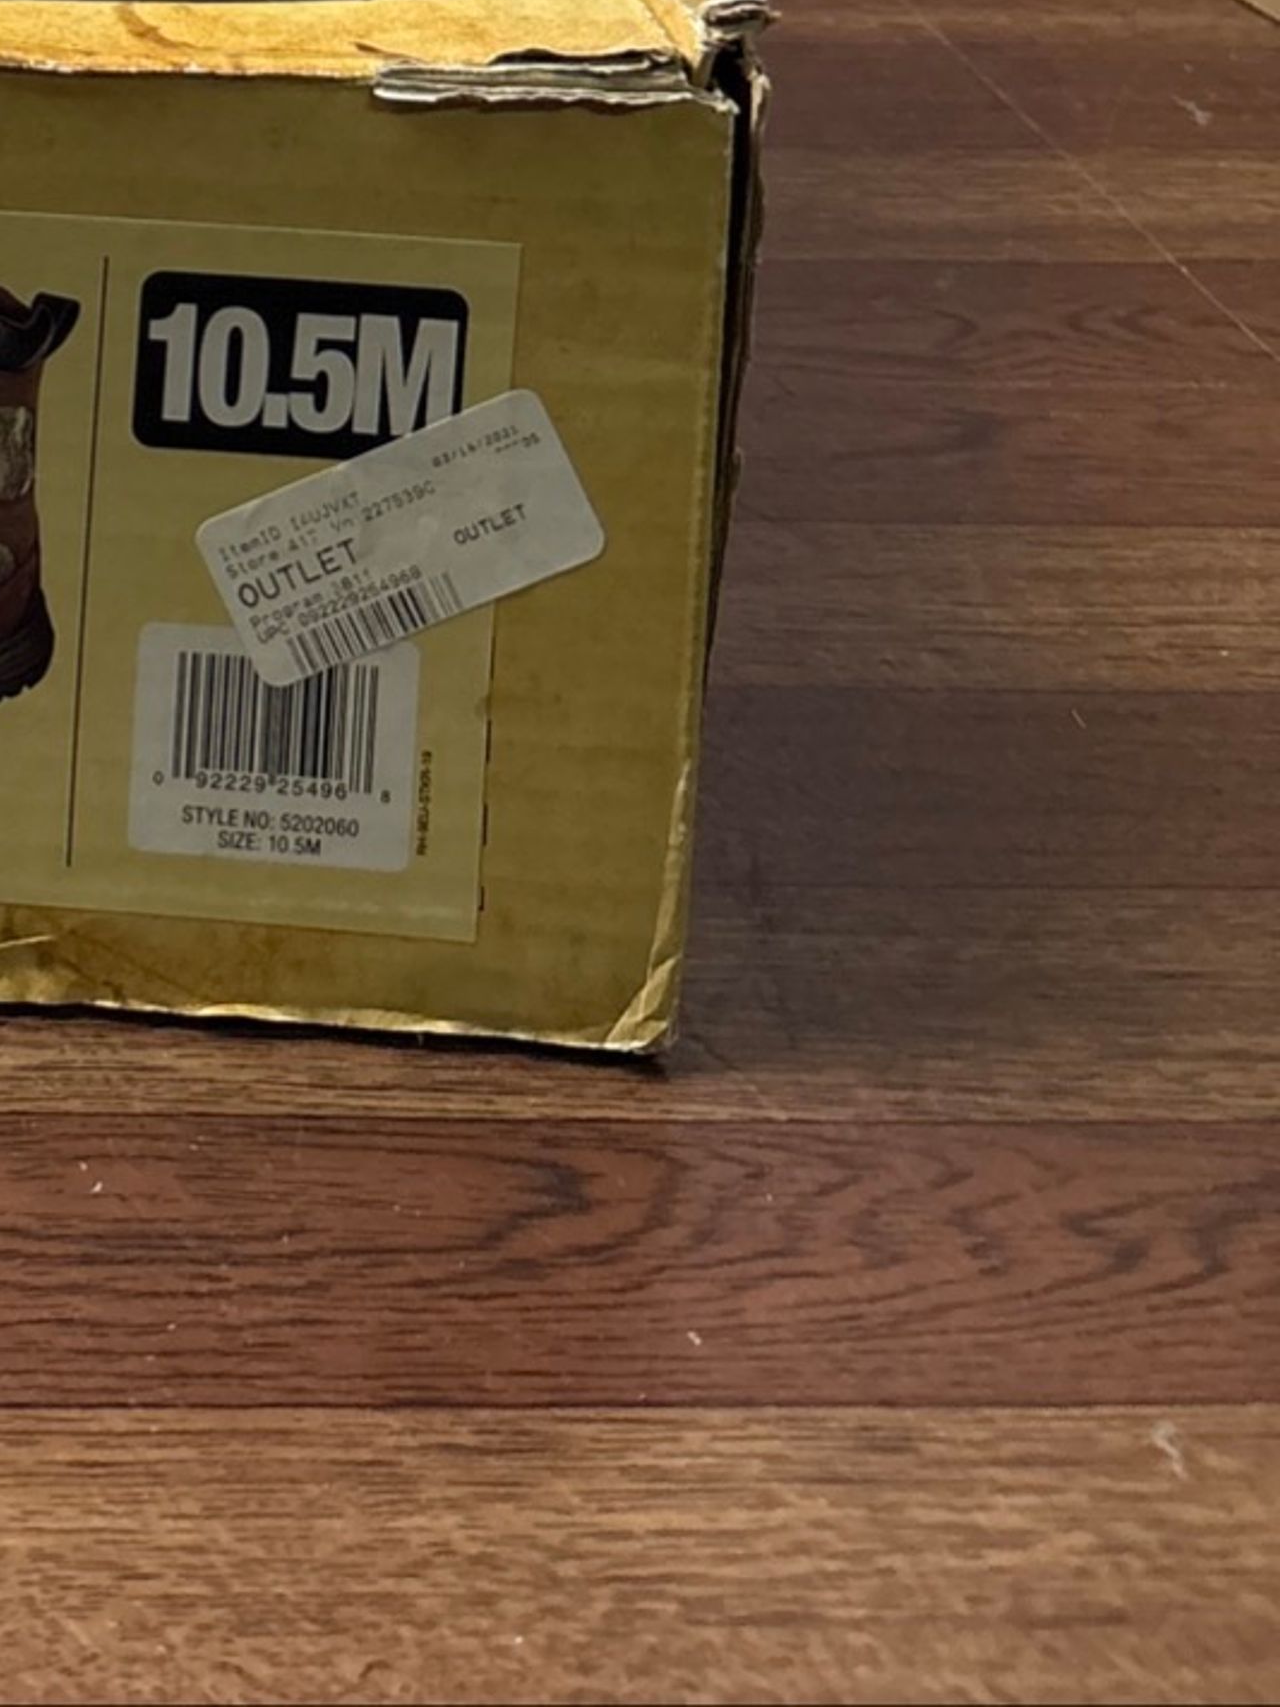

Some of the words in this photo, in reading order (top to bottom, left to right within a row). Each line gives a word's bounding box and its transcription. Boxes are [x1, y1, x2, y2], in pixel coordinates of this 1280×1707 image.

[146, 301, 461, 437] 10.5M
[218, 524, 283, 561] ItemID
[237, 537, 359, 610] OUTLET
[452, 503, 528, 546] OUTLET
[225, 550, 281, 581] Store
[249, 591, 324, 630] Program
[152, 771, 164, 785] 0
[195, 769, 268, 794] 92229
[276, 775, 350, 801] 25496
[381, 789, 391, 804] 8
[181, 804, 239, 827] STYLE
[243, 810, 276, 831] NO:
[279, 812, 361, 838] 5202060
[217, 829, 262, 851] SIZE:
